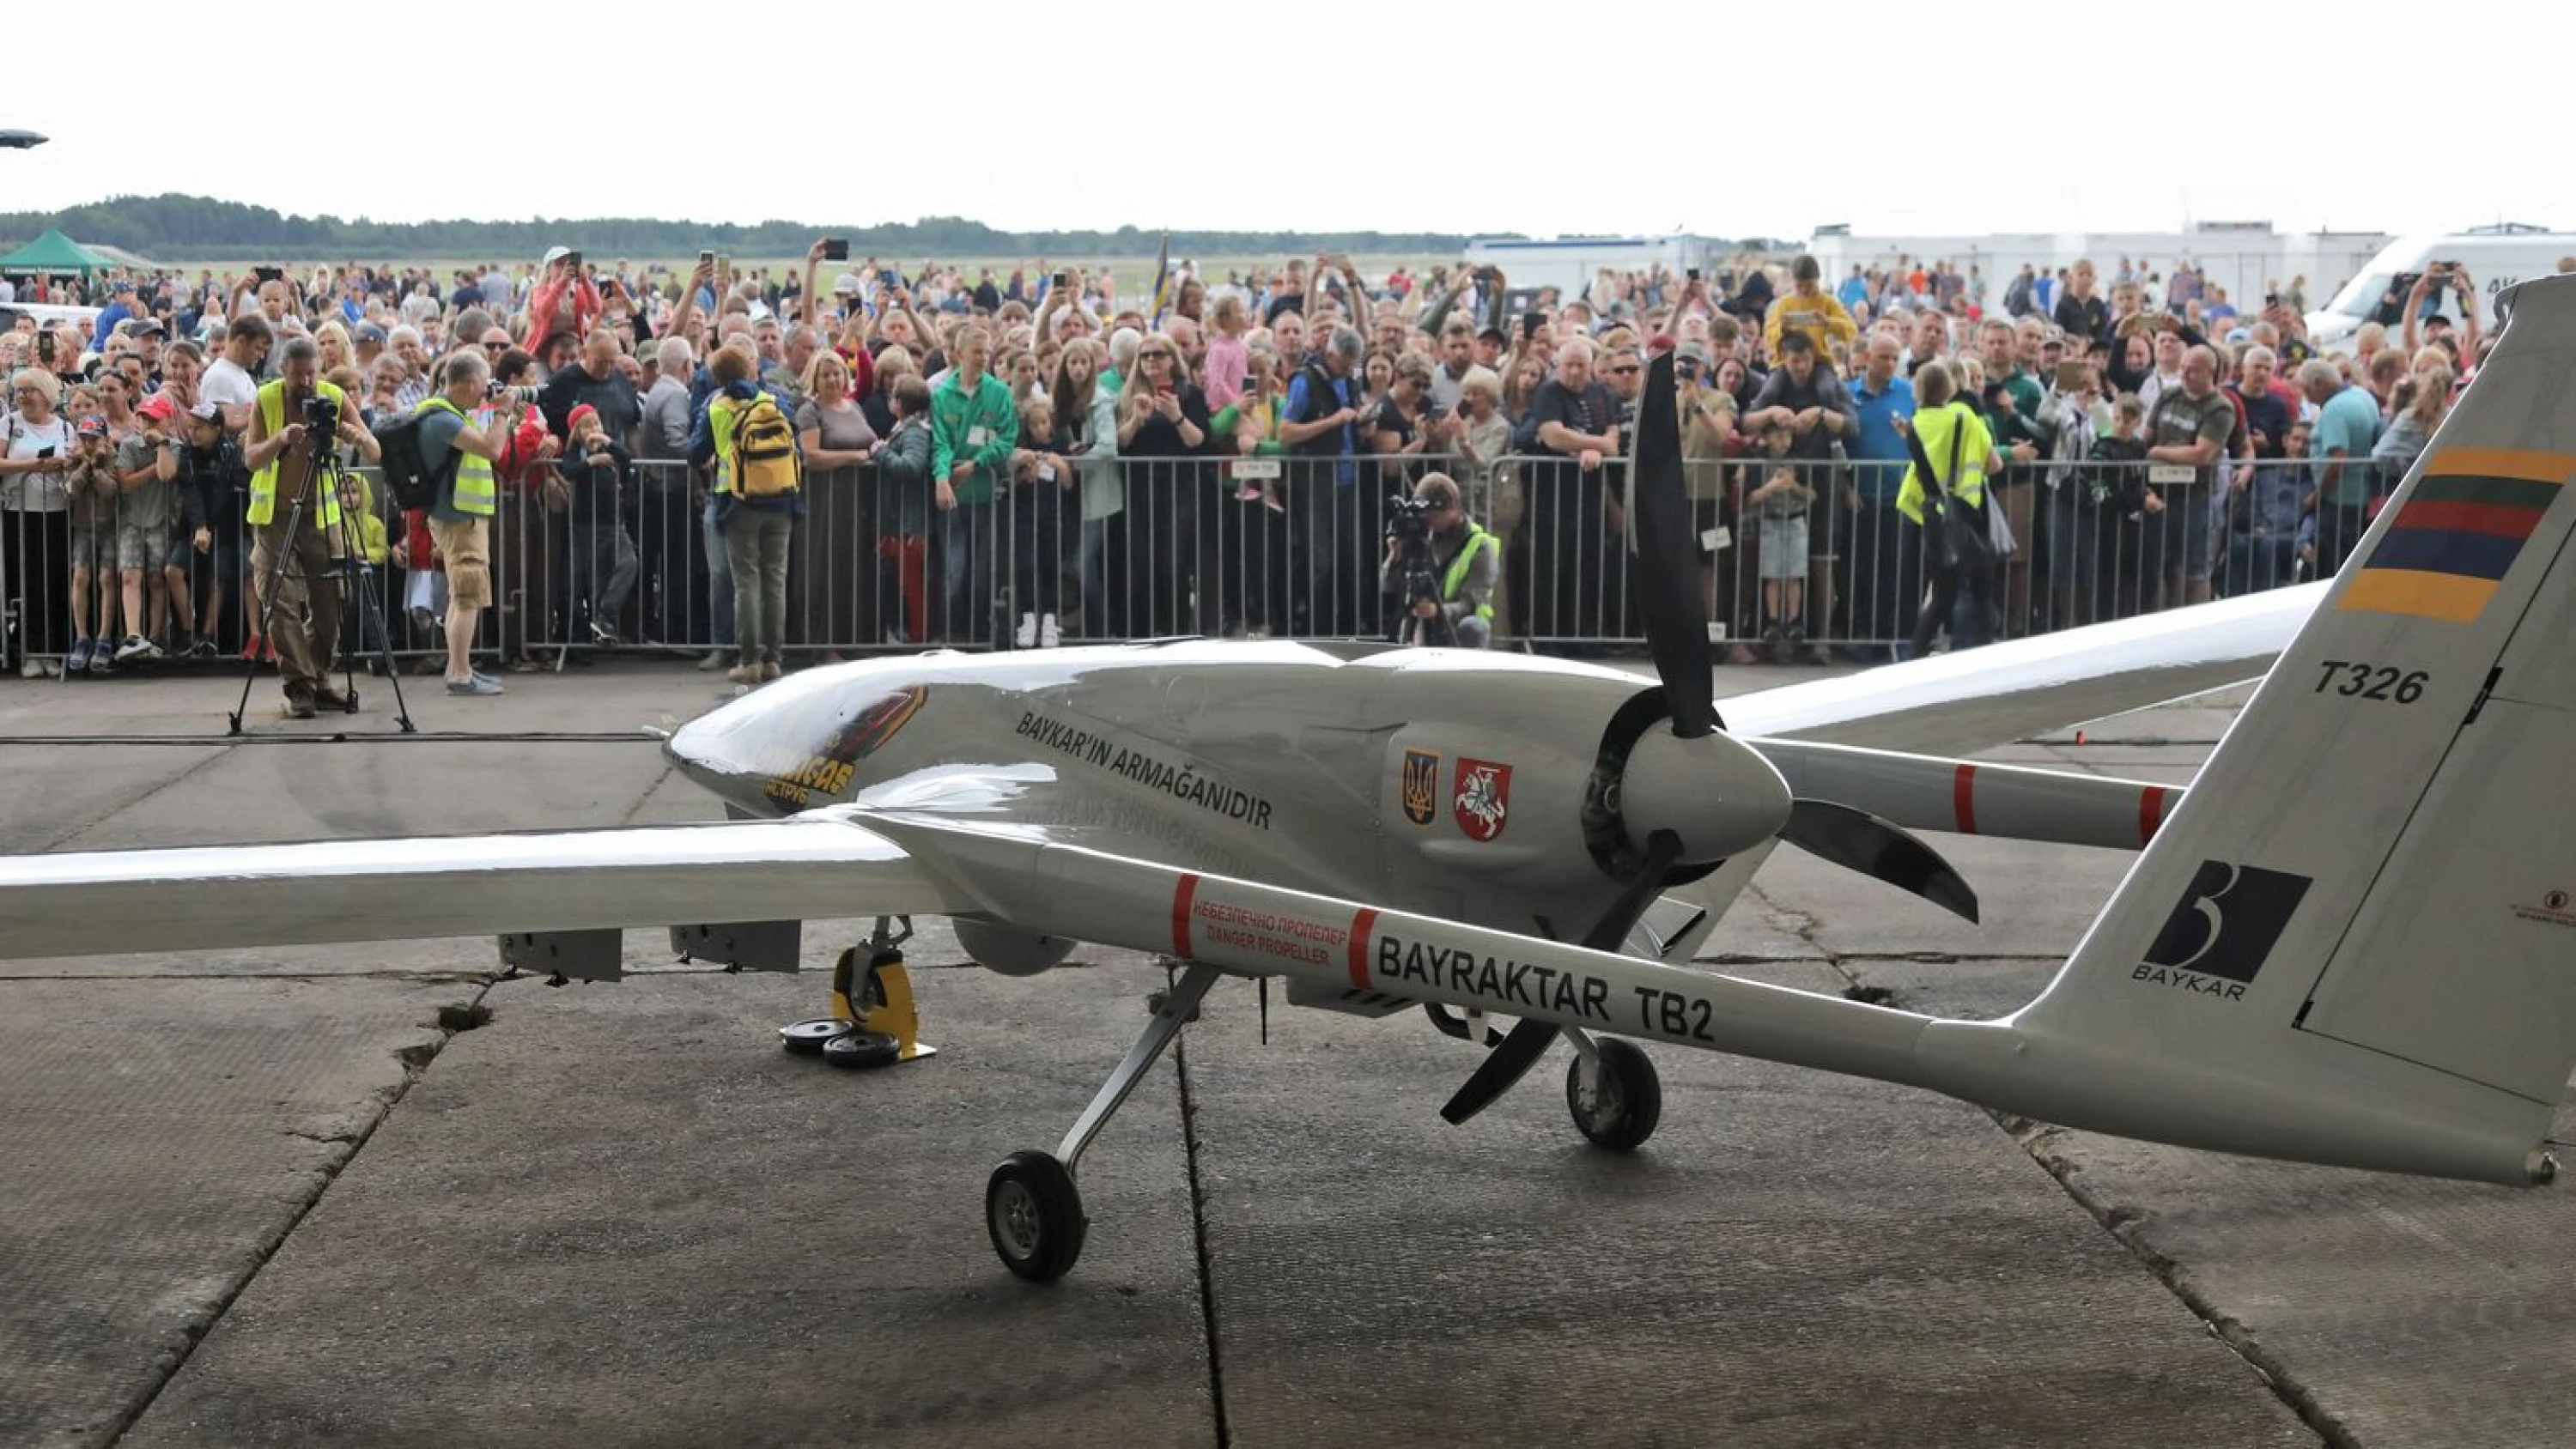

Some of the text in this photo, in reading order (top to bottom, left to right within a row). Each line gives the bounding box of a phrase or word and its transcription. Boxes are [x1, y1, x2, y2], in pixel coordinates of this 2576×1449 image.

[2315, 660, 2430, 704] T326
[1016, 711, 1273, 831] BAYKAR'IN ARMAĞANIDIR
[1193, 900, 1346, 945] НЕБЕЗПЕЧНО ПРОПЕЛЕР
[1206, 925, 1329, 965] DANGER PROPELLER
[1378, 936, 1716, 1042] BAYRAKTAR TB2
[2131, 965, 2246, 1003] BAYKAR
